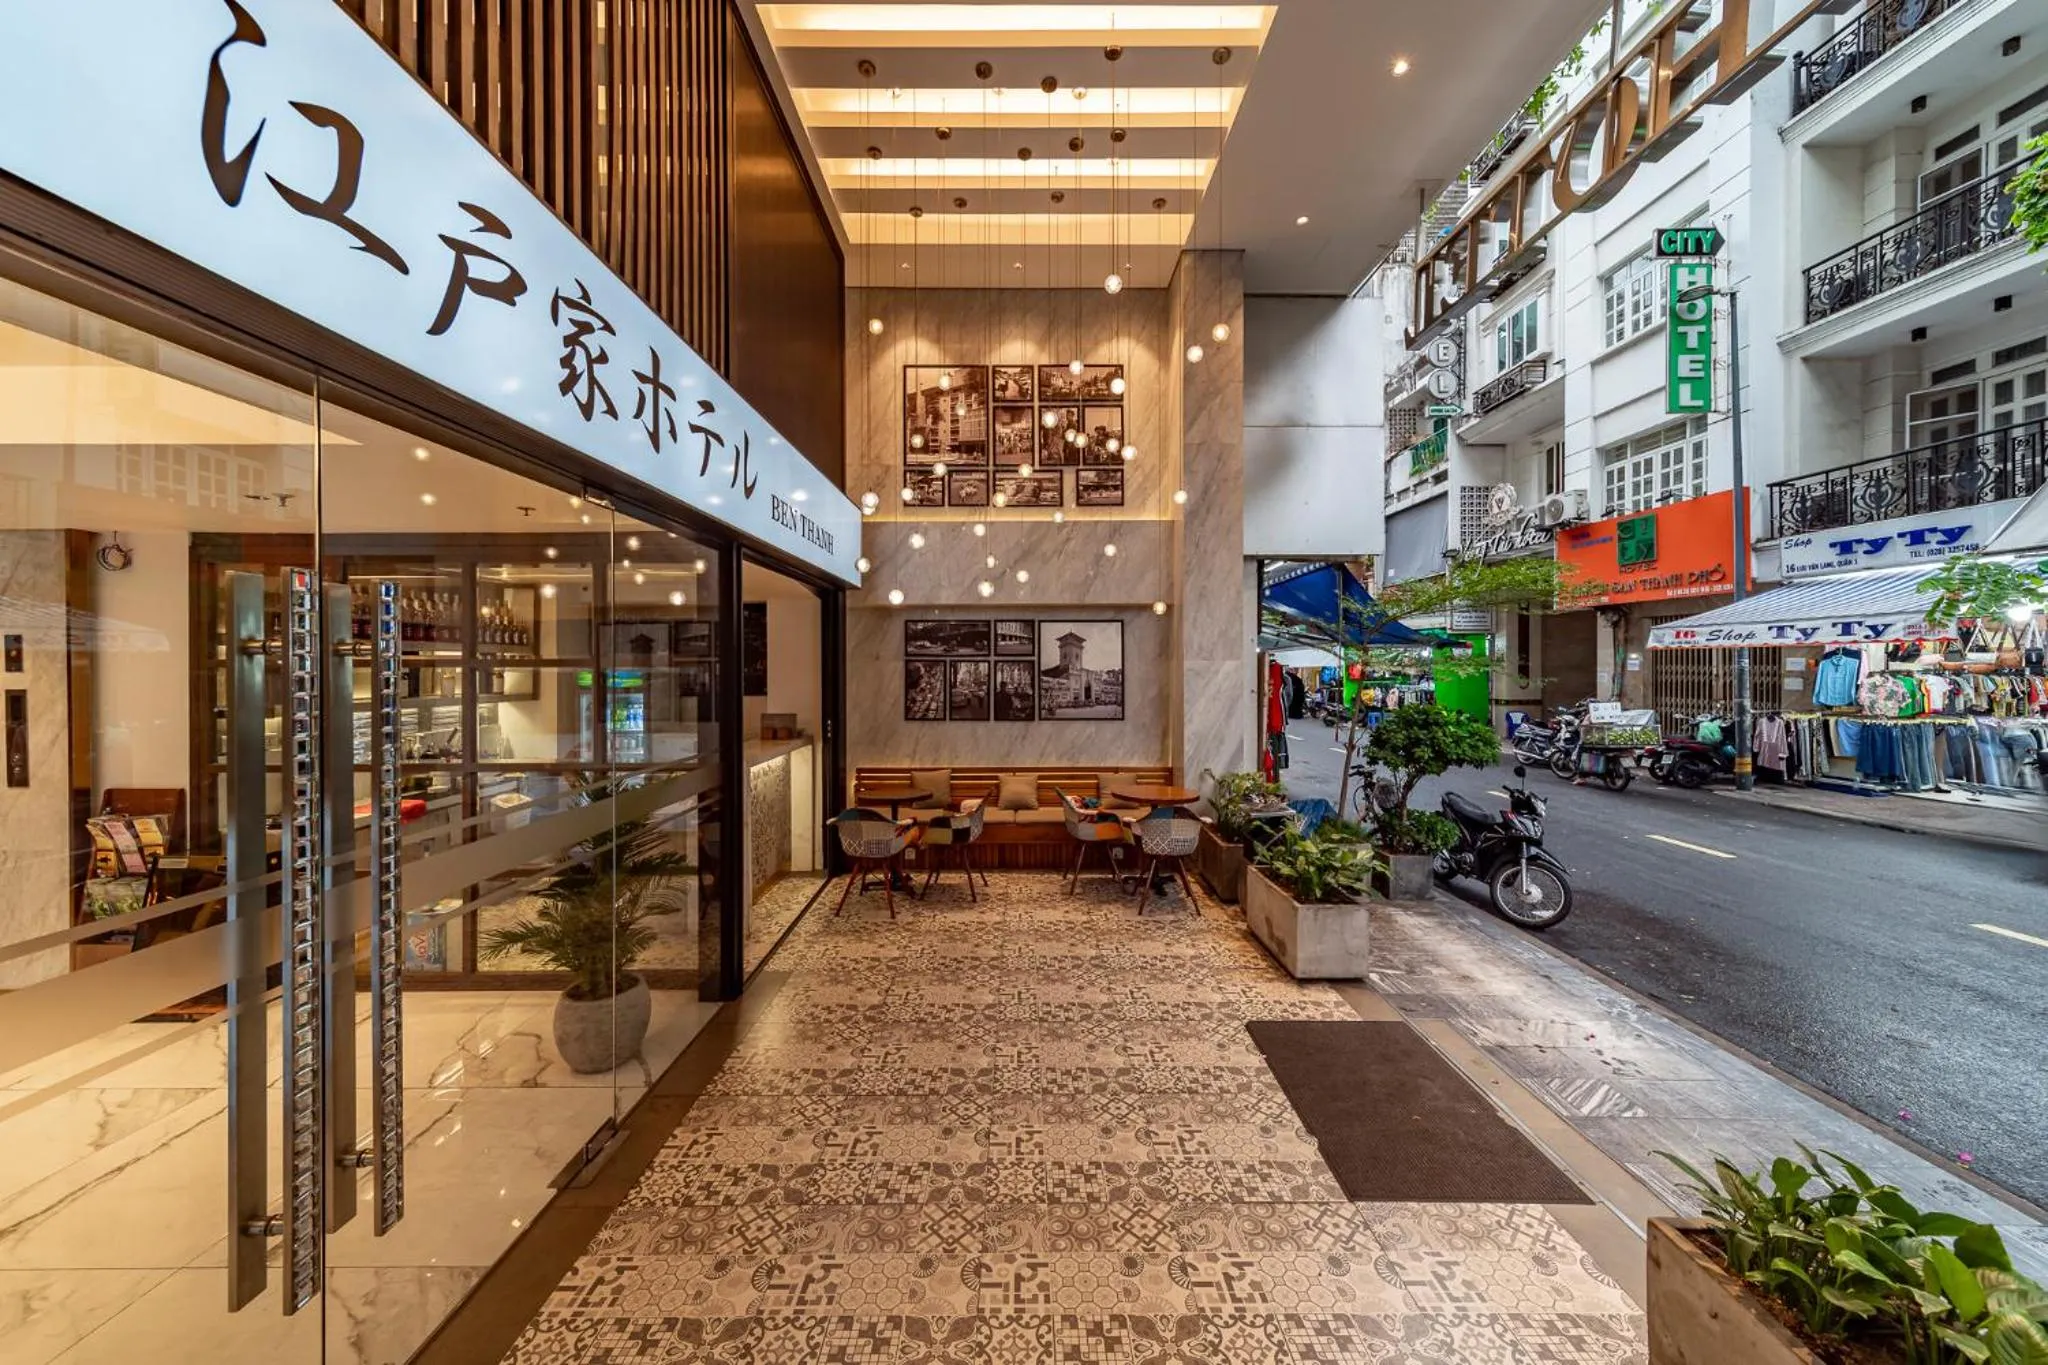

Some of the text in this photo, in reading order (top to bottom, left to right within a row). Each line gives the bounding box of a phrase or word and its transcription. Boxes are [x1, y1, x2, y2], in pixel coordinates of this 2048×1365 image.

[1661, 230, 1716, 254] CITY
[1676, 267, 1707, 407] HOTEL
[771, 493, 834, 555] BEN THANH
[1784, 537, 1812, 550] Shop
[1786, 563, 1796, 574] 16
[1705, 629, 1758, 643] Shop
[1768, 624, 1821, 641] Ty
[1832, 619, 1894, 639] Ty
